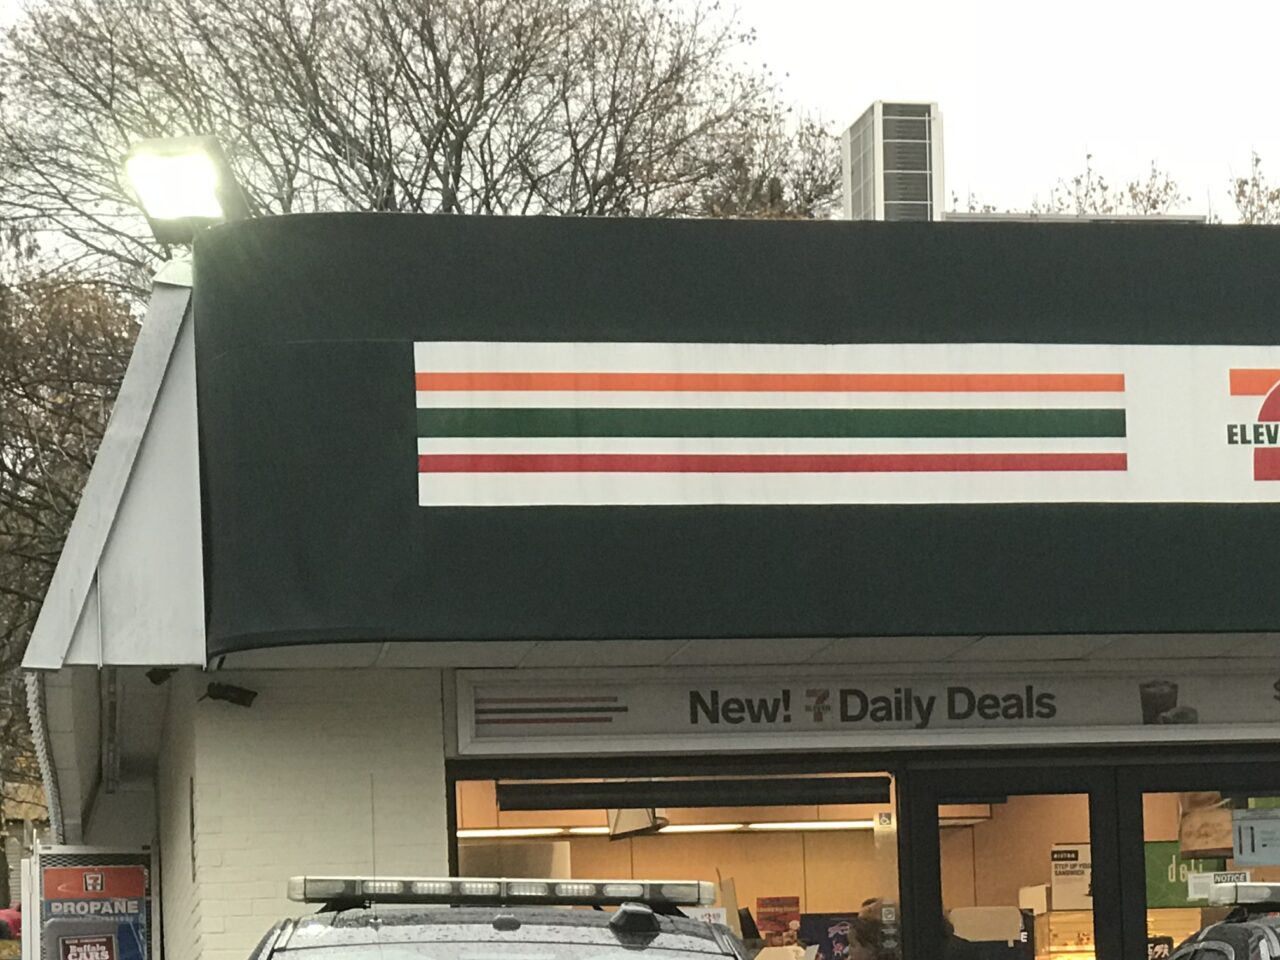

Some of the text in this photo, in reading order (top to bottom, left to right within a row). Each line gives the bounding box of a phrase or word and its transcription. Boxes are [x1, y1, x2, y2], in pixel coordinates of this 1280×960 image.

[689, 690, 792, 725] New!
[839, 688, 937, 729] Daily
[947, 685, 1057, 721] Deals
[1214, 873, 1247, 883] NOTICE
[51, 901, 139, 914] PROPANE
[69, 944, 106, 953] Buffalo
